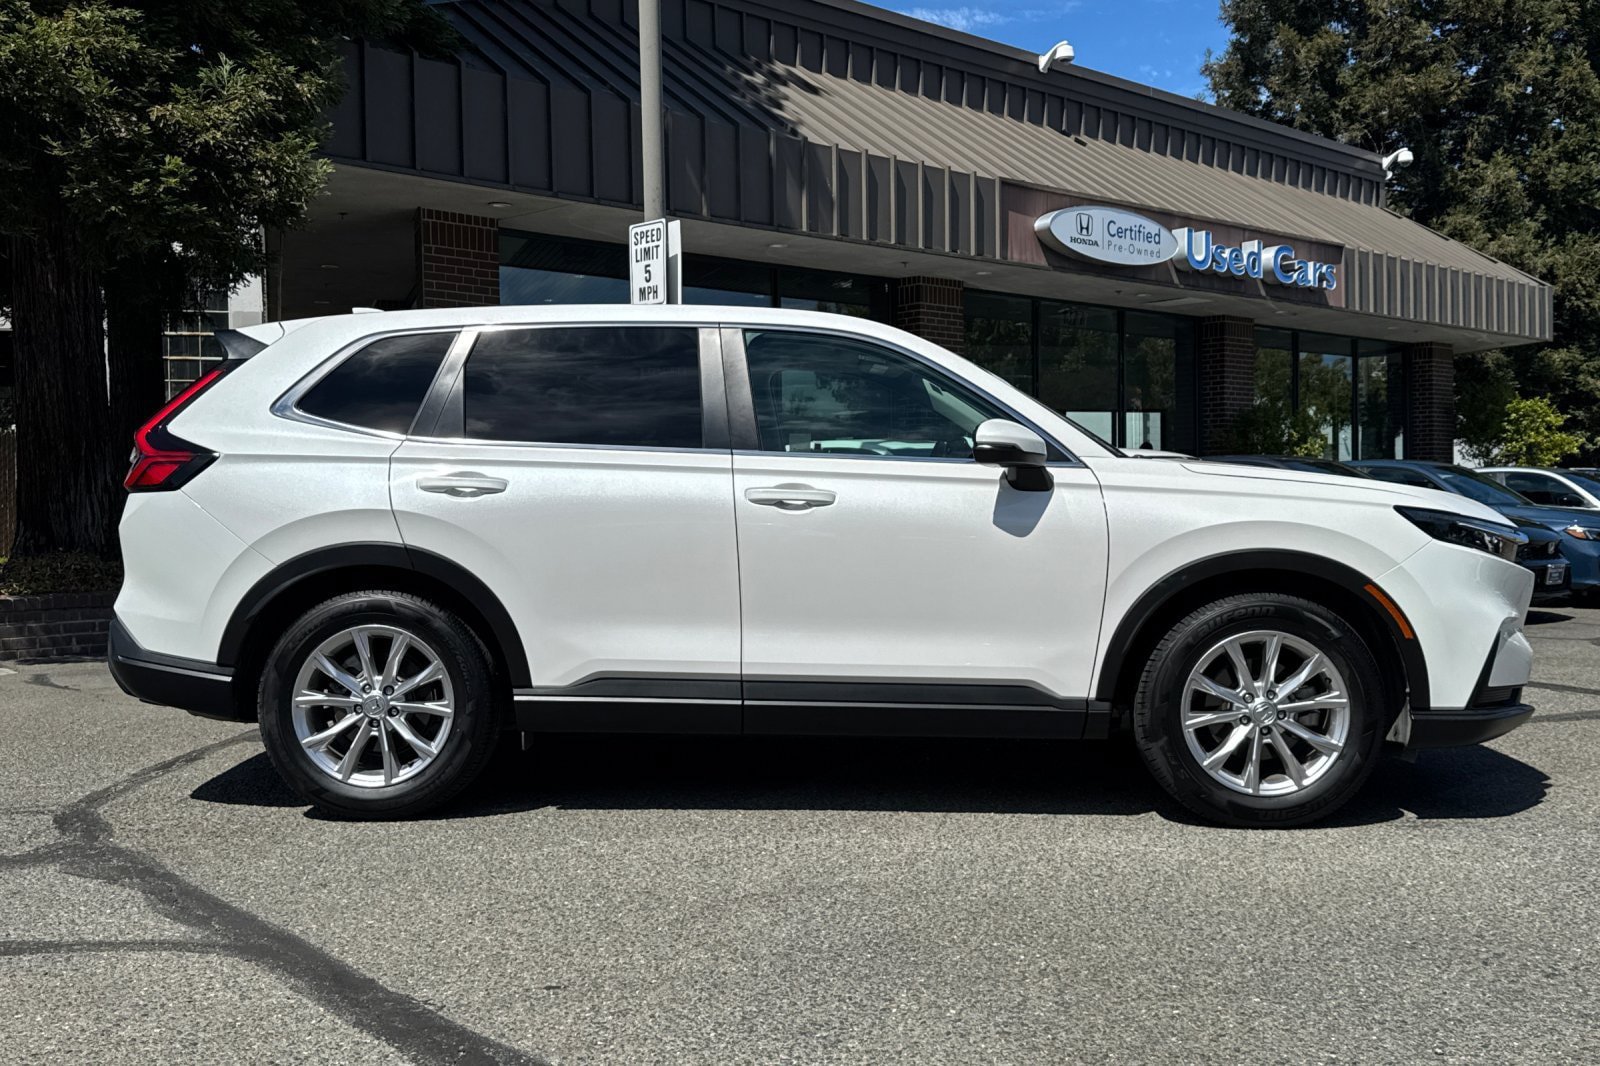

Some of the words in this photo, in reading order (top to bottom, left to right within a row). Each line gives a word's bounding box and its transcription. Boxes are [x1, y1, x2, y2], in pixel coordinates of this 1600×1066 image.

[634, 228, 662, 246] SPEED
[1070, 236, 1100, 247] HONDA
[1107, 220, 1161, 245] Certified
[635, 245, 660, 263] LIMIT
[1107, 240, 1161, 259] Pre-Owned
[1185, 227, 1264, 279] Used
[1272, 244, 1337, 290] Cars
[644, 264, 651, 283] 5
[639, 285, 658, 302] MPH
